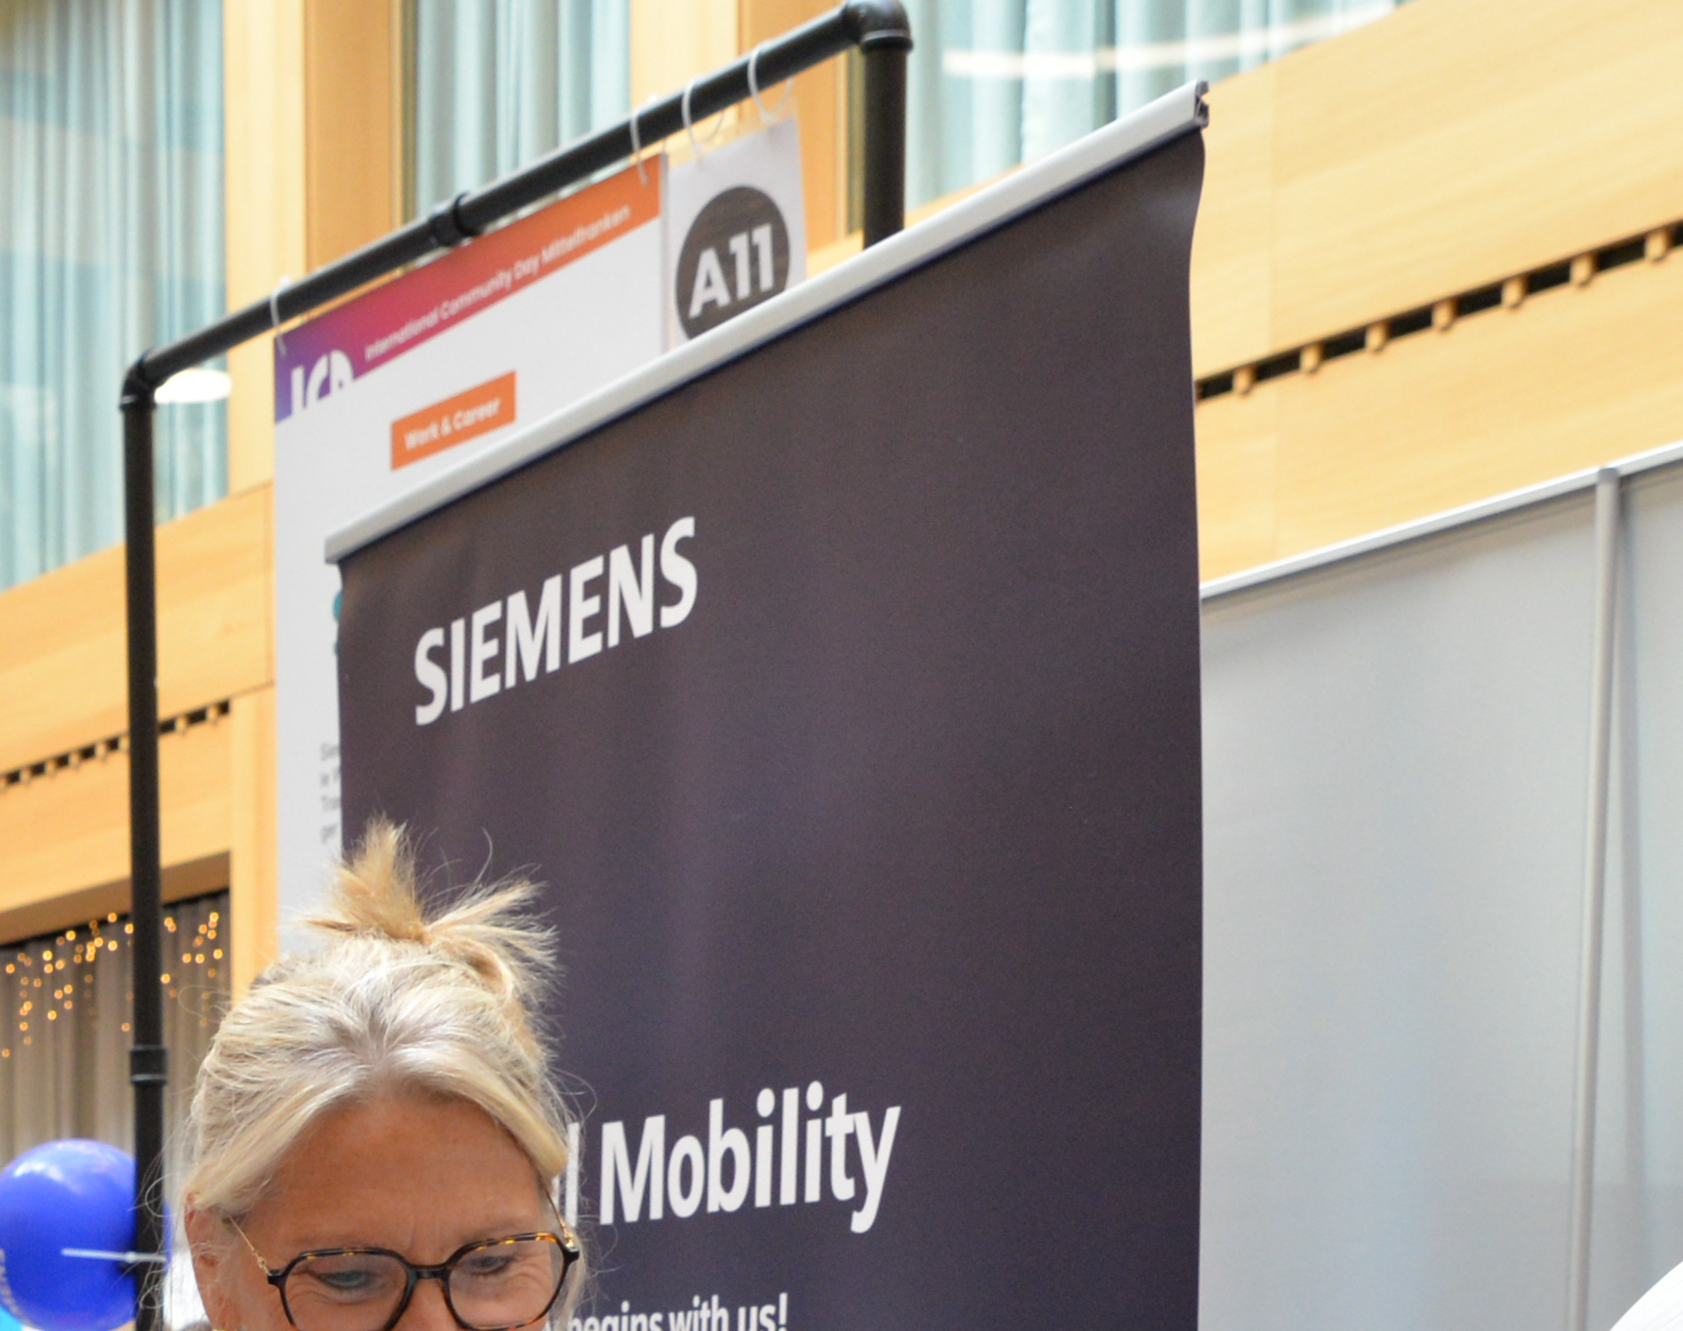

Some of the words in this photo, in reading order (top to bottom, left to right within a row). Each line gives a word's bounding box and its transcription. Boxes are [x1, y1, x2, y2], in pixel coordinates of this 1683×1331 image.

[365, 305, 439, 361] International
[439, 266, 512, 321] Community
[513, 253, 541, 283] Day
[541, 205, 631, 265] Mittelfranken
[688, 222, 775, 320] A11
[404, 424, 439, 451] Work
[440, 415, 453, 437] &
[453, 398, 502, 430] Career
[414, 516, 699, 726] SIEMENS
[600, 1080, 901, 1233] Mobility
